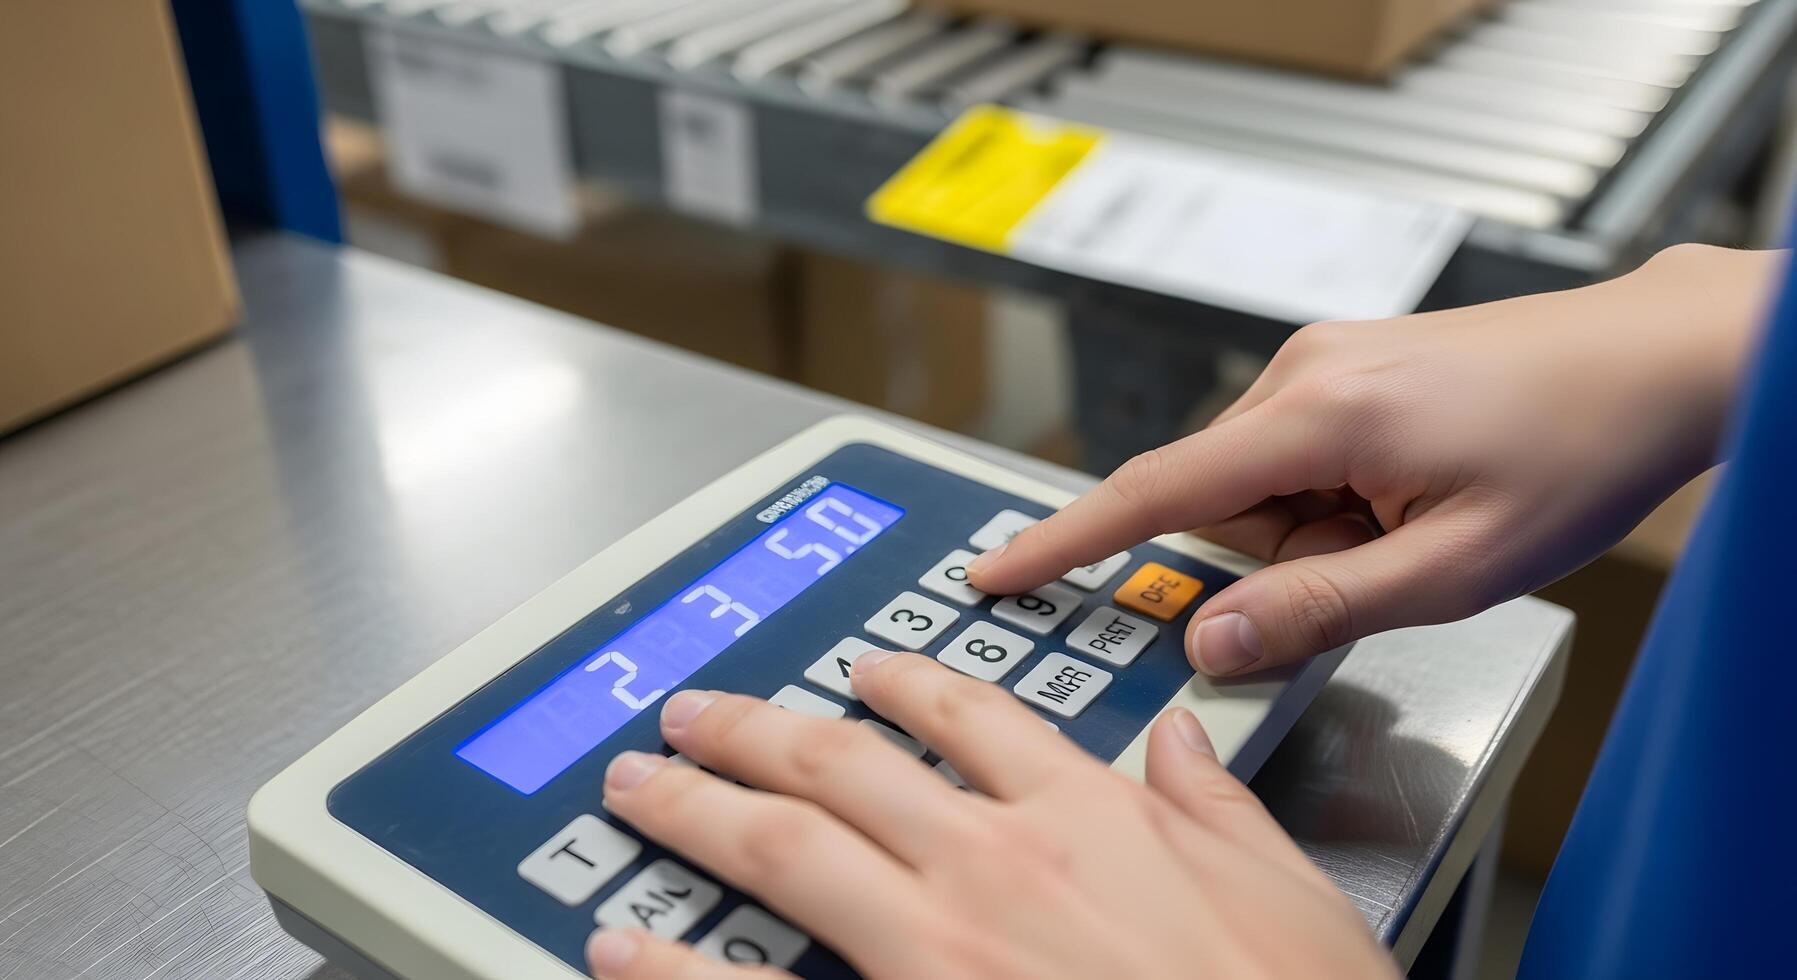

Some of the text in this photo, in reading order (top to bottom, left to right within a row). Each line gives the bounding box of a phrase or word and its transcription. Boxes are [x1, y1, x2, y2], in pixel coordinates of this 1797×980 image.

[1016, 595, 1057, 616] 9
[890, 609, 933, 632] 3
[585, 651, 666, 710] 2
[681, 584, 760, 638] 3
[965, 639, 1008, 663] 8
[549, 838, 596, 868] T
